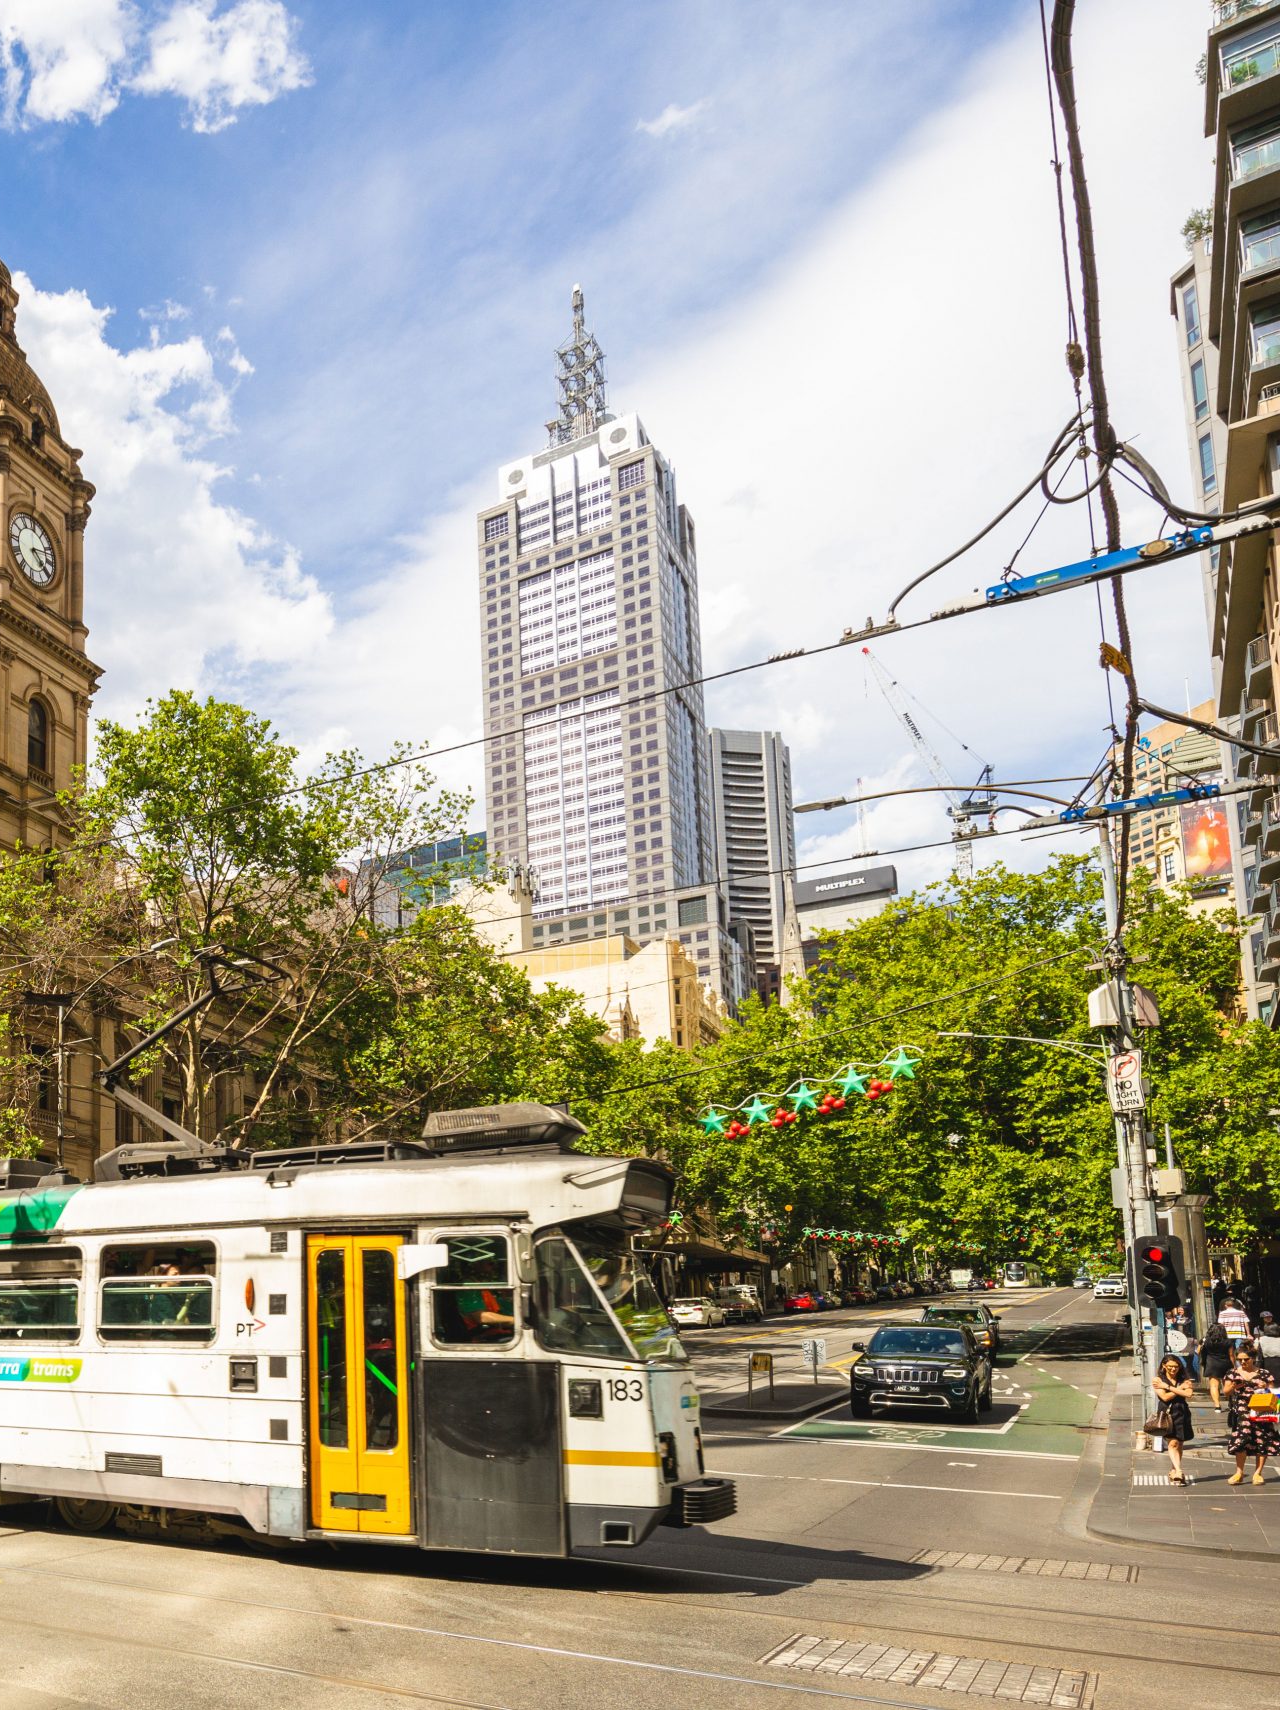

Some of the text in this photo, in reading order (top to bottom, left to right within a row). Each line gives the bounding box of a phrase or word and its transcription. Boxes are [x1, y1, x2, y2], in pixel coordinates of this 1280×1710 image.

[903, 712, 923, 741] MULTIPLEX
[815, 877, 865, 892] MULTIPLEX
[1115, 1080, 1132, 1090] NO
[1117, 1098, 1140, 1107] TURN
[33, 1363, 74, 1377] trams
[606, 1379, 643, 1401] 183
